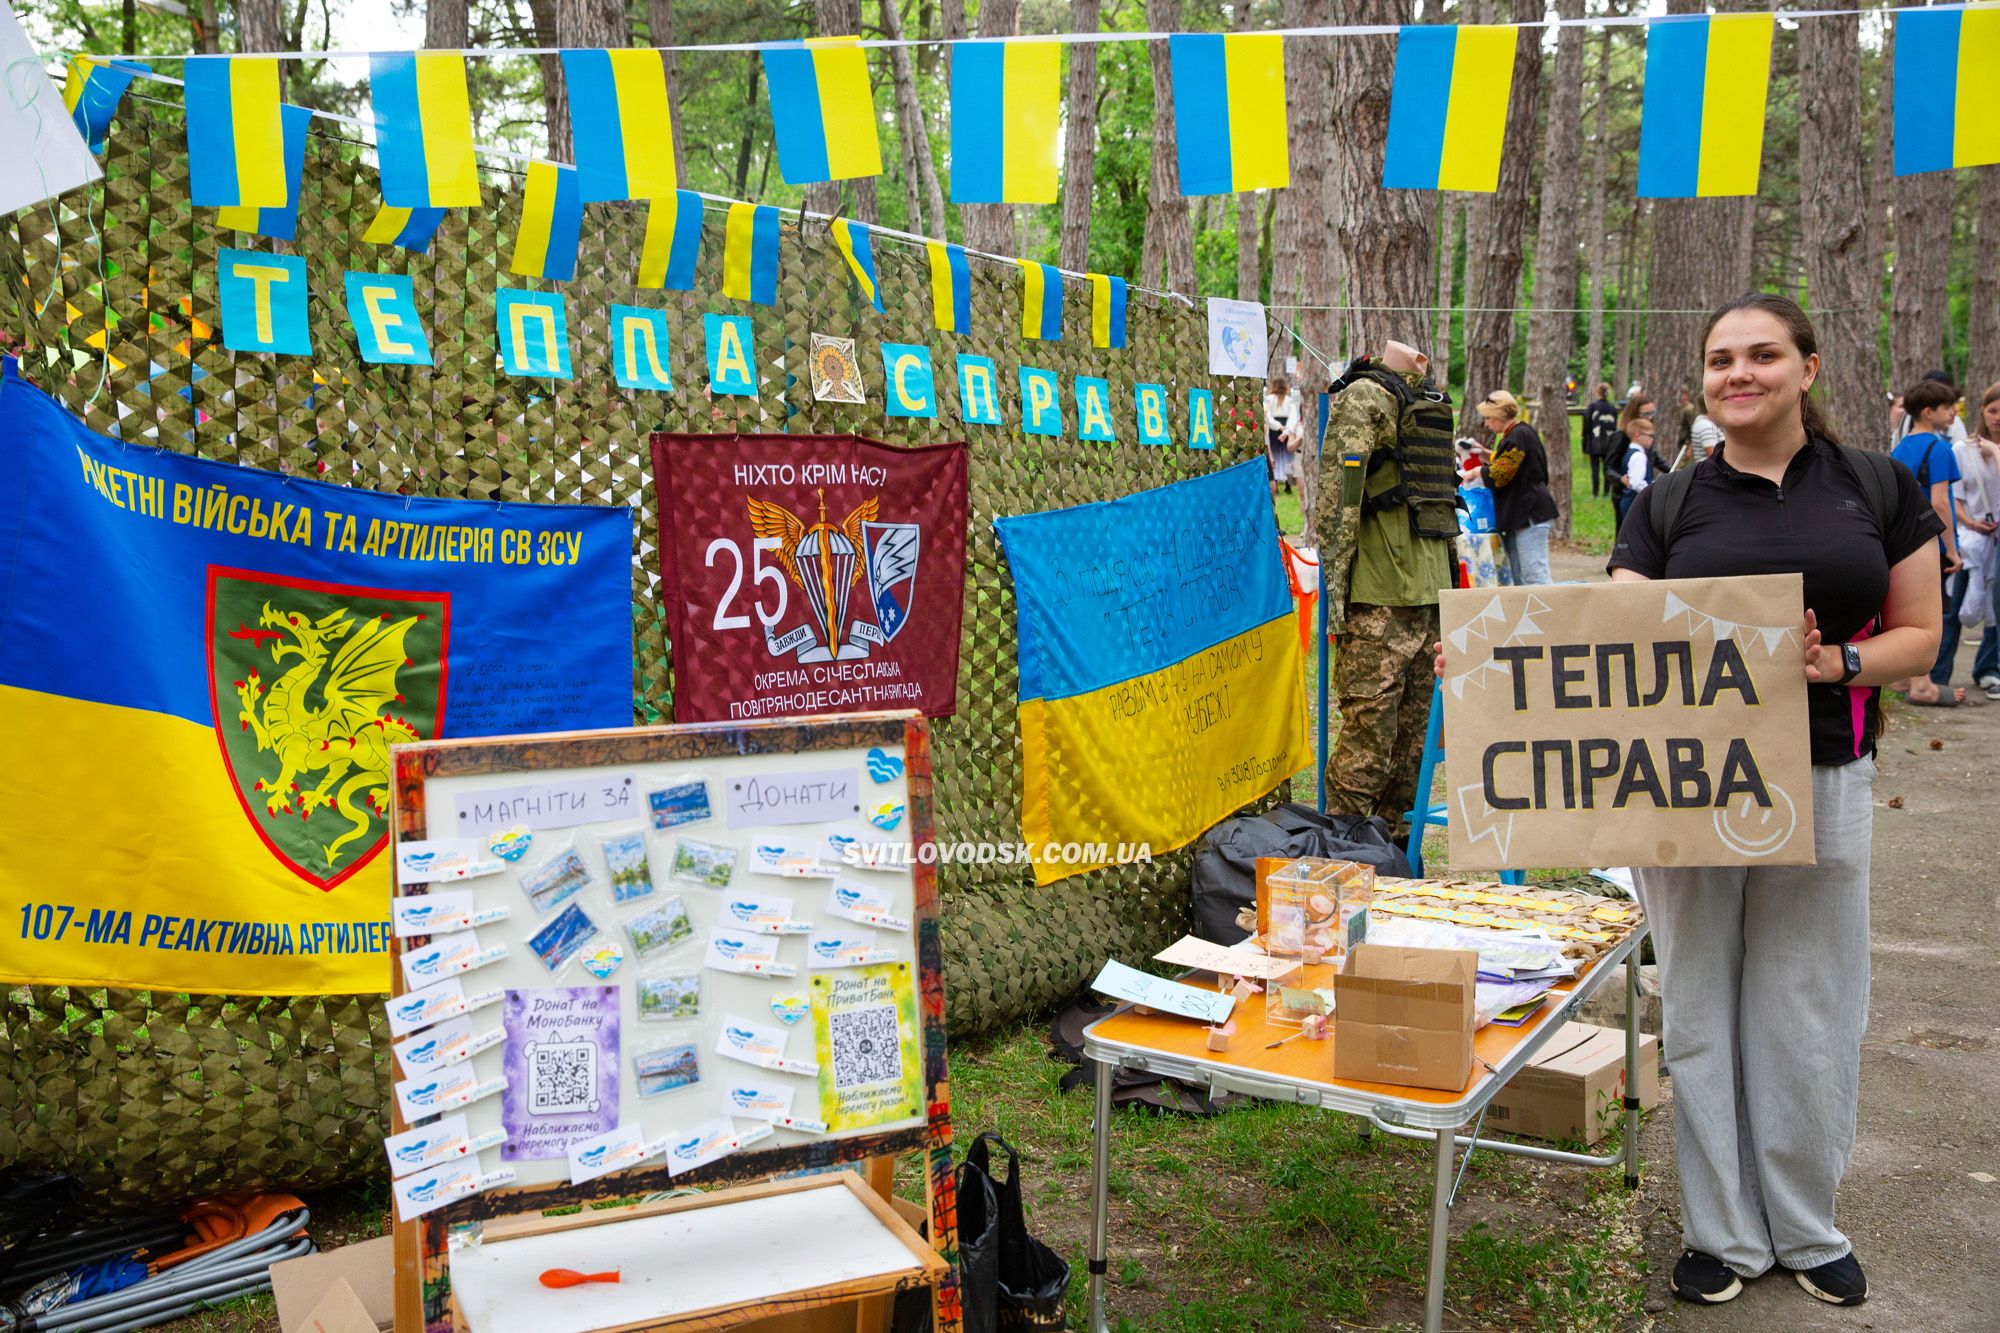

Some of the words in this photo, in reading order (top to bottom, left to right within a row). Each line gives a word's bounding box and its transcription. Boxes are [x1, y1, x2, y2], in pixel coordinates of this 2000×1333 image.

[233, 263, 752, 386] ТЕПЛА
[893, 356, 1213, 445] СПРАВА
[734, 464, 796, 486] НІХТО
[801, 463, 846, 485] КРІМ
[173, 483, 312, 547] ВІЙСЬКА
[323, 510, 356, 553] ТА
[361, 518, 494, 563] АРТИЛЕРІЯ
[501, 528, 532, 565] СВ
[537, 531, 583, 565] ЗСУ
[705, 537, 788, 631] 25
[774, 626, 808, 652] ЗАВЖДИ
[754, 669, 810, 691] ОКРЕМА
[1492, 638, 1761, 711] ТЕПЛА
[1481, 737, 1774, 811] СПРАВА
[602, 786, 630, 807] ЗА
[20, 903, 133, 945] 107-МА
[138, 913, 295, 956] РЕАКТИВНА
[873, 976, 888, 987] на
[581, 999, 598, 1011] на
[522, 1121, 601, 1138] Наближаємо
[518, 1138, 569, 1152] перемогу
